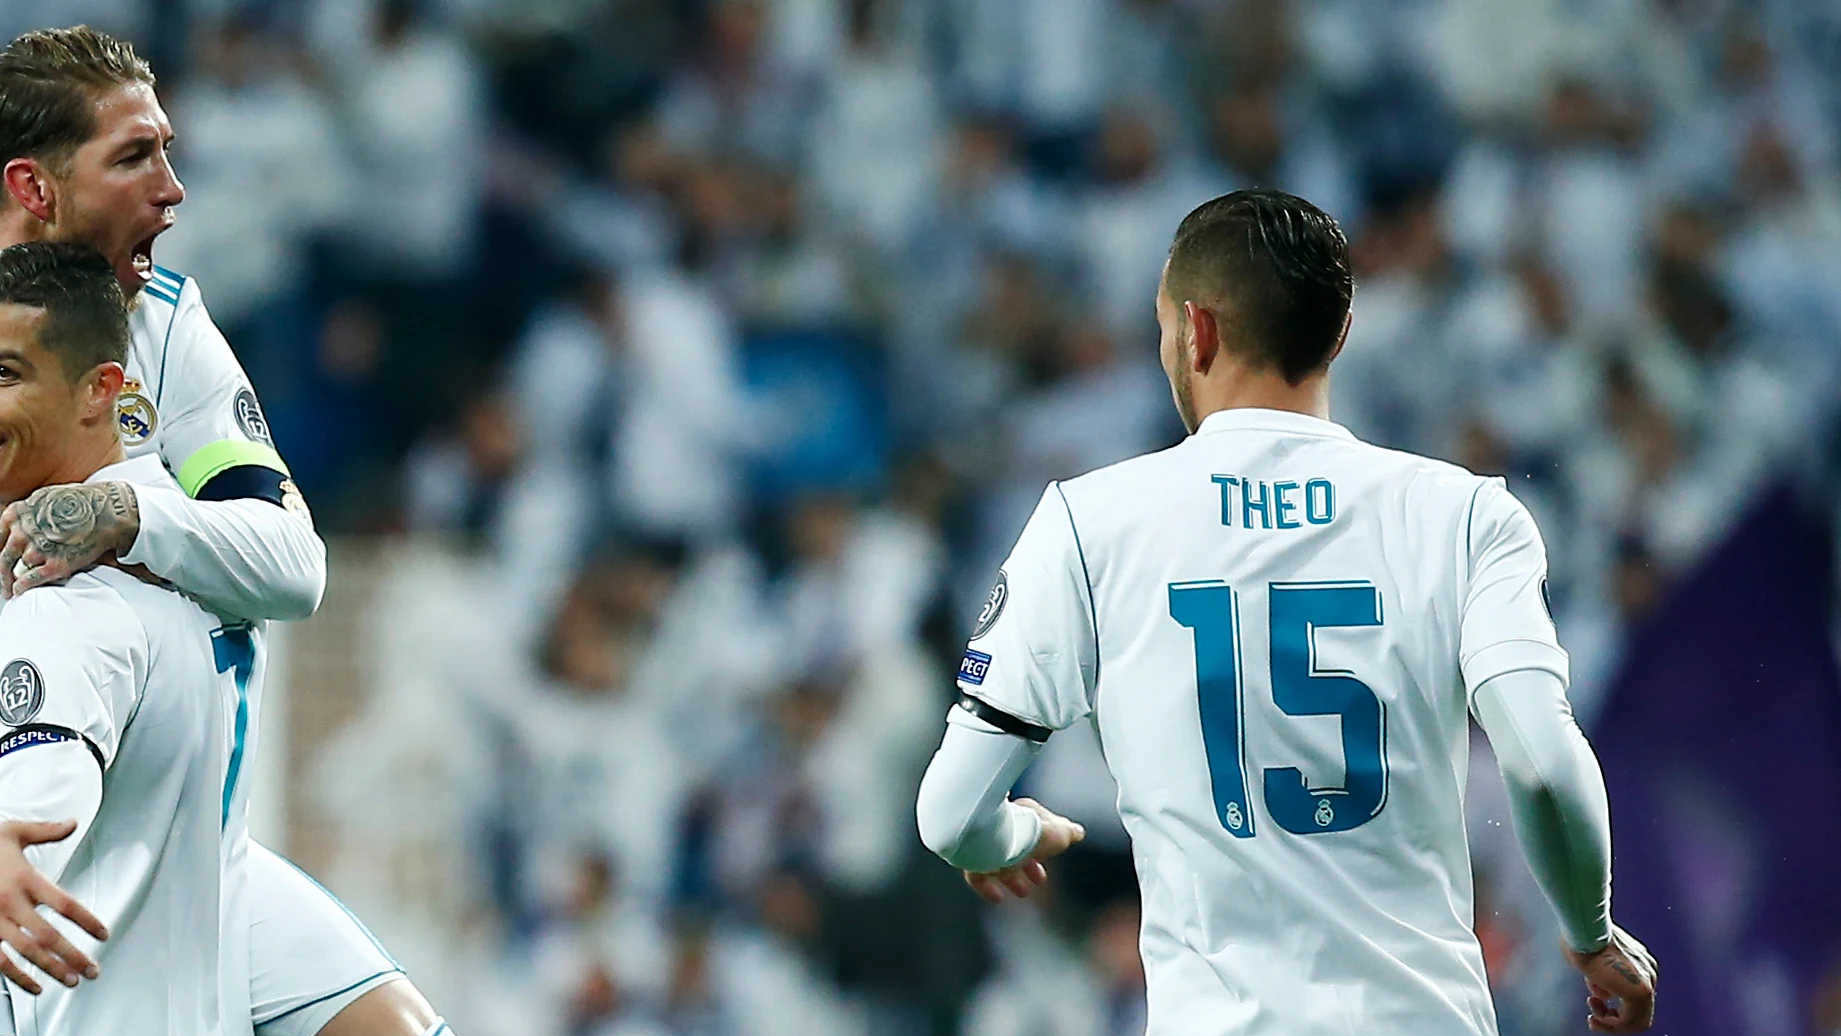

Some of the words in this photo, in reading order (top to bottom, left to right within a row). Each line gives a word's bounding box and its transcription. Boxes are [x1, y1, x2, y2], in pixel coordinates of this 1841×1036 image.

[1211, 473, 1336, 529] THEO
[7, 687, 29, 711] 12
[1168, 579, 1390, 839] 15
